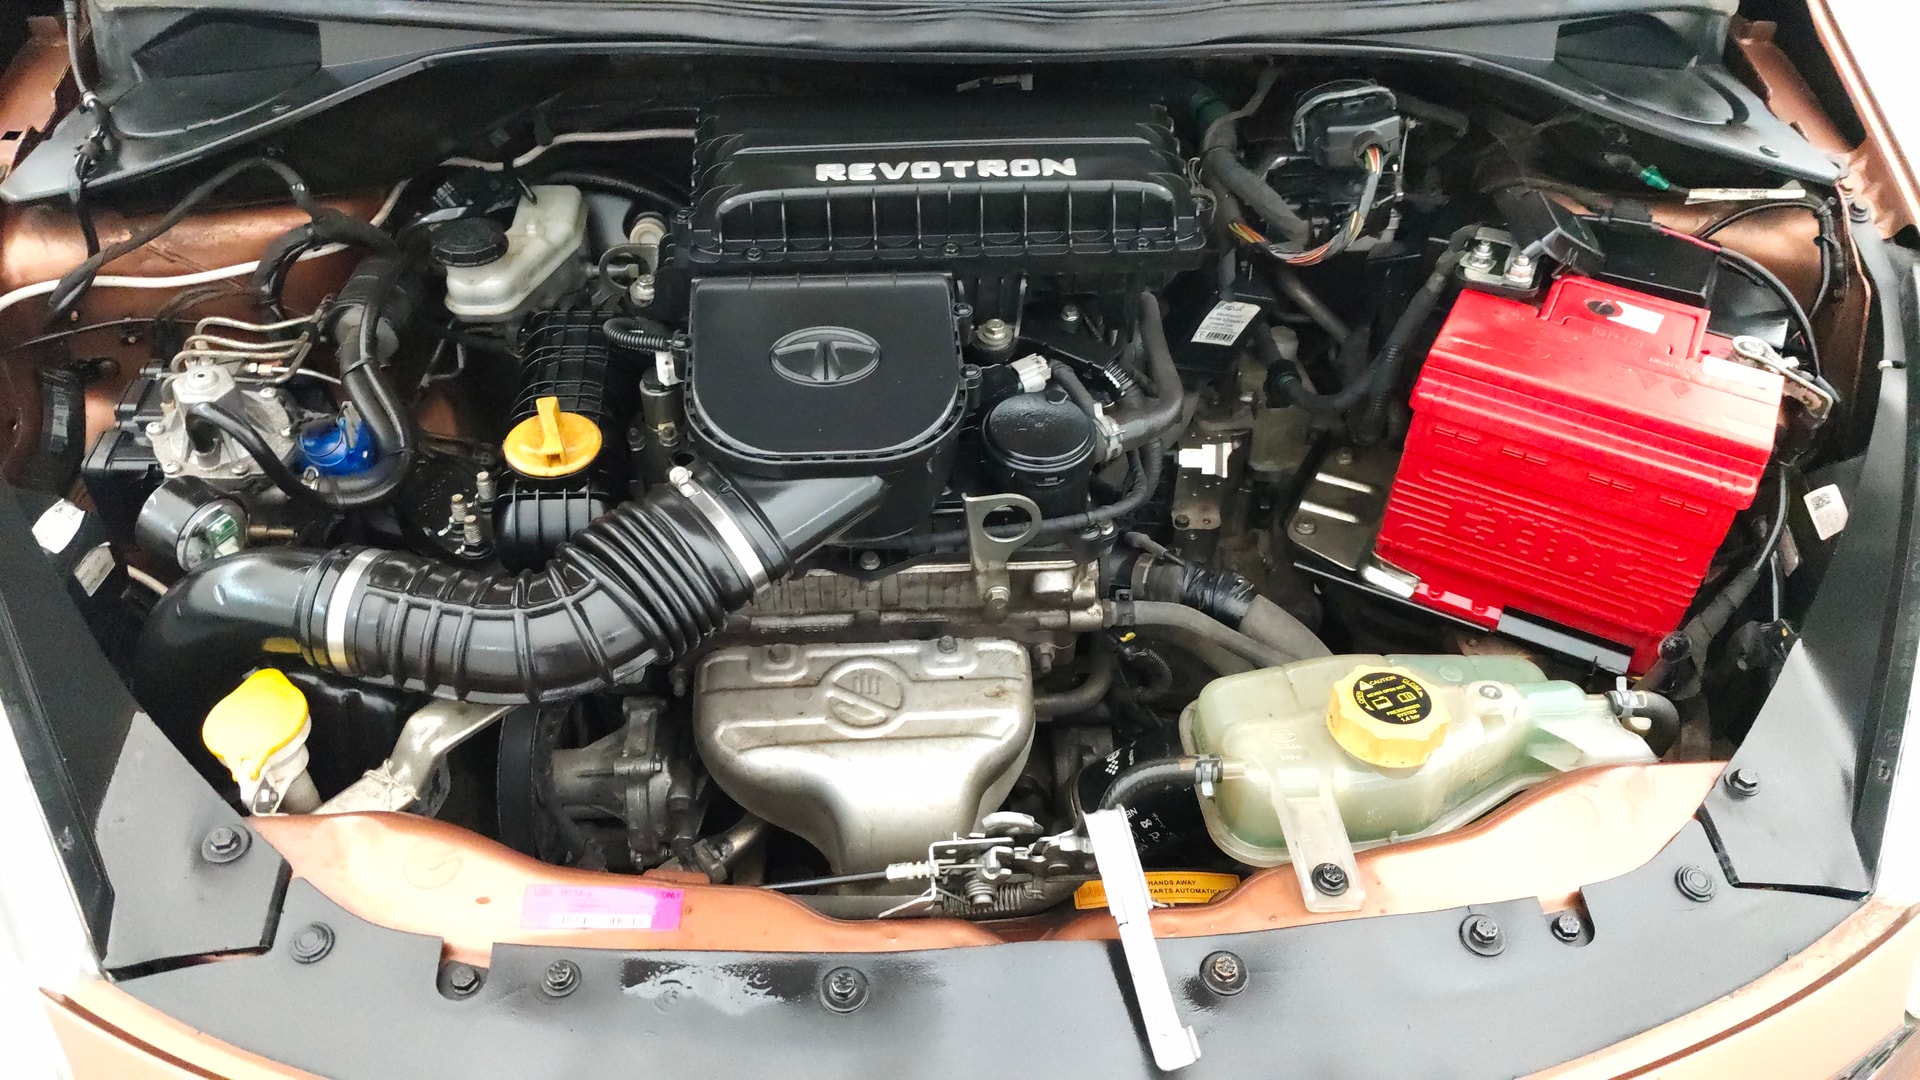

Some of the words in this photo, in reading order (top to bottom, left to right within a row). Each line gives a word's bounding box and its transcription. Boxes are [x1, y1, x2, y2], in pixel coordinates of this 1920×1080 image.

[815, 157, 1078, 182] REVOTRON
[1446, 499, 1641, 590] EXIDE
[1369, 675, 1396, 685] CAUTION
[661, 890, 682, 899] ONLY
